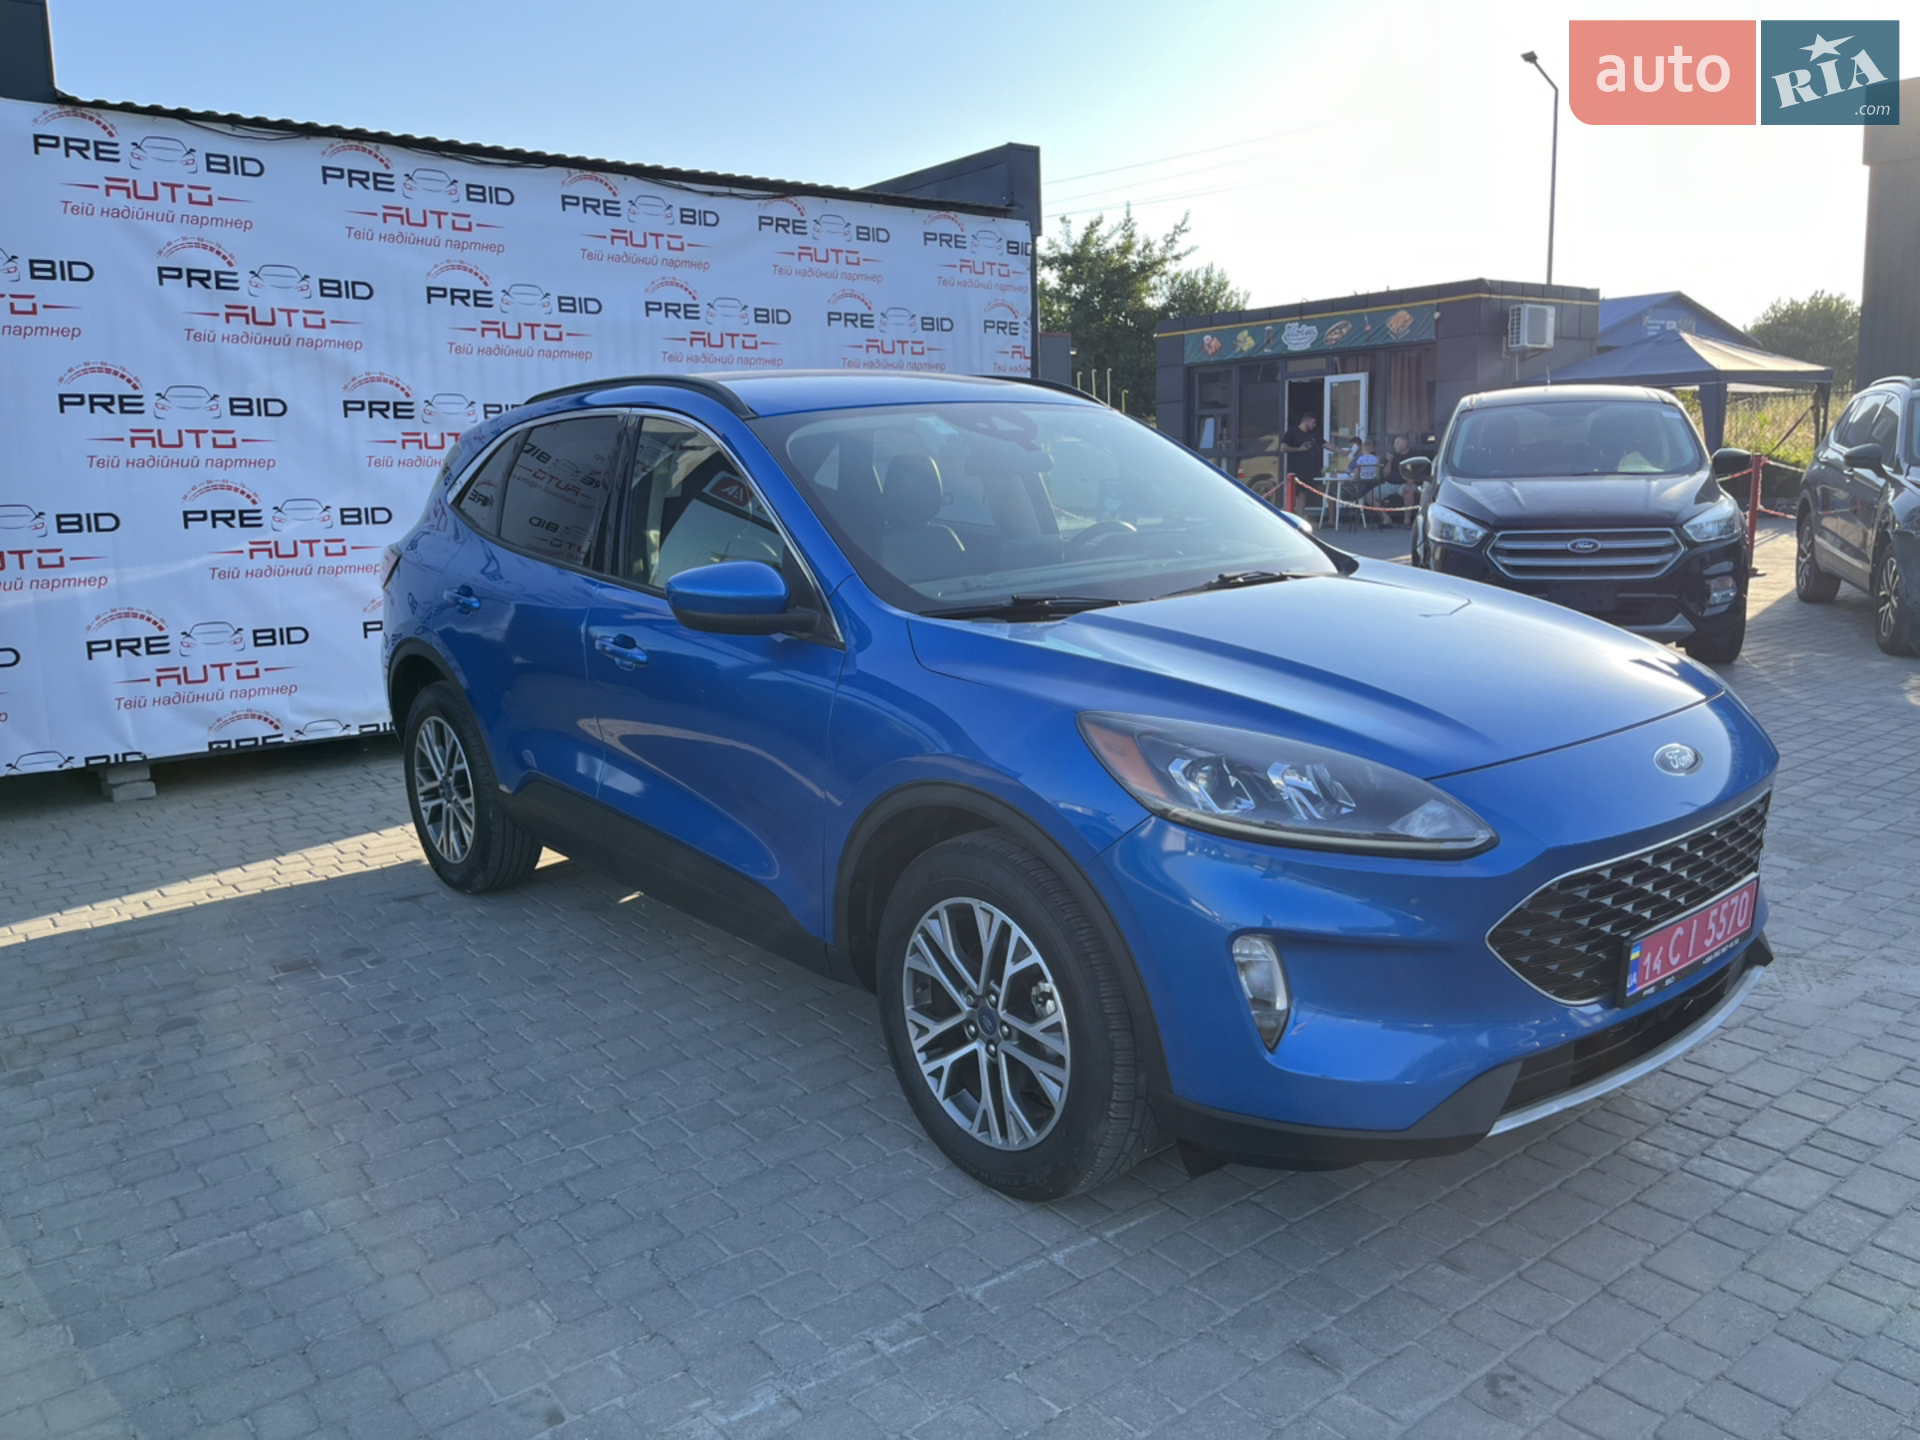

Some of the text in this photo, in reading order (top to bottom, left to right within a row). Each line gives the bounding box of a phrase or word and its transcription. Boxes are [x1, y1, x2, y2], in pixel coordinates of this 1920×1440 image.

[33, 134, 264, 177] PRE BID
[104, 177, 213, 209] AUTO
[321, 165, 514, 206] PRE BID
[61, 200, 253, 232] Твій надійний партнер
[382, 205, 472, 232] AUTO
[560, 194, 719, 227] PRE BID
[345, 226, 505, 255] Твій надійний партнер
[611, 229, 684, 251] AUTO
[758, 216, 890, 243] PRE BID
[923, 232, 967, 249] PRE
[580, 248, 710, 272] Твій надійний партнер
[798, 246, 860, 266] AUTO
[29, 259, 94, 282] BID
[959, 259, 1010, 278] AUTO
[157, 266, 374, 300] PRE BID
[426, 286, 602, 314] PRE BID
[225, 304, 326, 329] AUTO
[645, 301, 791, 324] PRE BID
[827, 312, 954, 332] PRE BID
[2, 325, 81, 340] партнер
[481, 320, 563, 341] AUTO
[984, 320, 1019, 336] PRE
[184, 328, 363, 352] Твій надійний партнер
[690, 331, 758, 350] AUTO
[866, 339, 925, 355] AUTO
[447, 342, 592, 362] Твій надійний партнер
[662, 351, 783, 368] Твій надійний партнер
[58, 394, 287, 417] PRE BID
[343, 400, 415, 419] PRE
[129, 429, 237, 448] AUTO
[87, 455, 276, 471] Твій надійний партнер
[366, 456, 393, 467] Твій
[56, 513, 120, 533] BID
[183, 507, 392, 529] PRE BID
[249, 539, 347, 560] AUTO
[209, 567, 240, 580] Твій
[245, 564, 313, 578] надійний
[29, 576, 108, 592] партнер
[86, 627, 309, 660] PRE BID
[156, 661, 260, 687] AUTO
[115, 684, 298, 710] Твій надійний партнер
[1704, 890, 1750, 948] 5570
